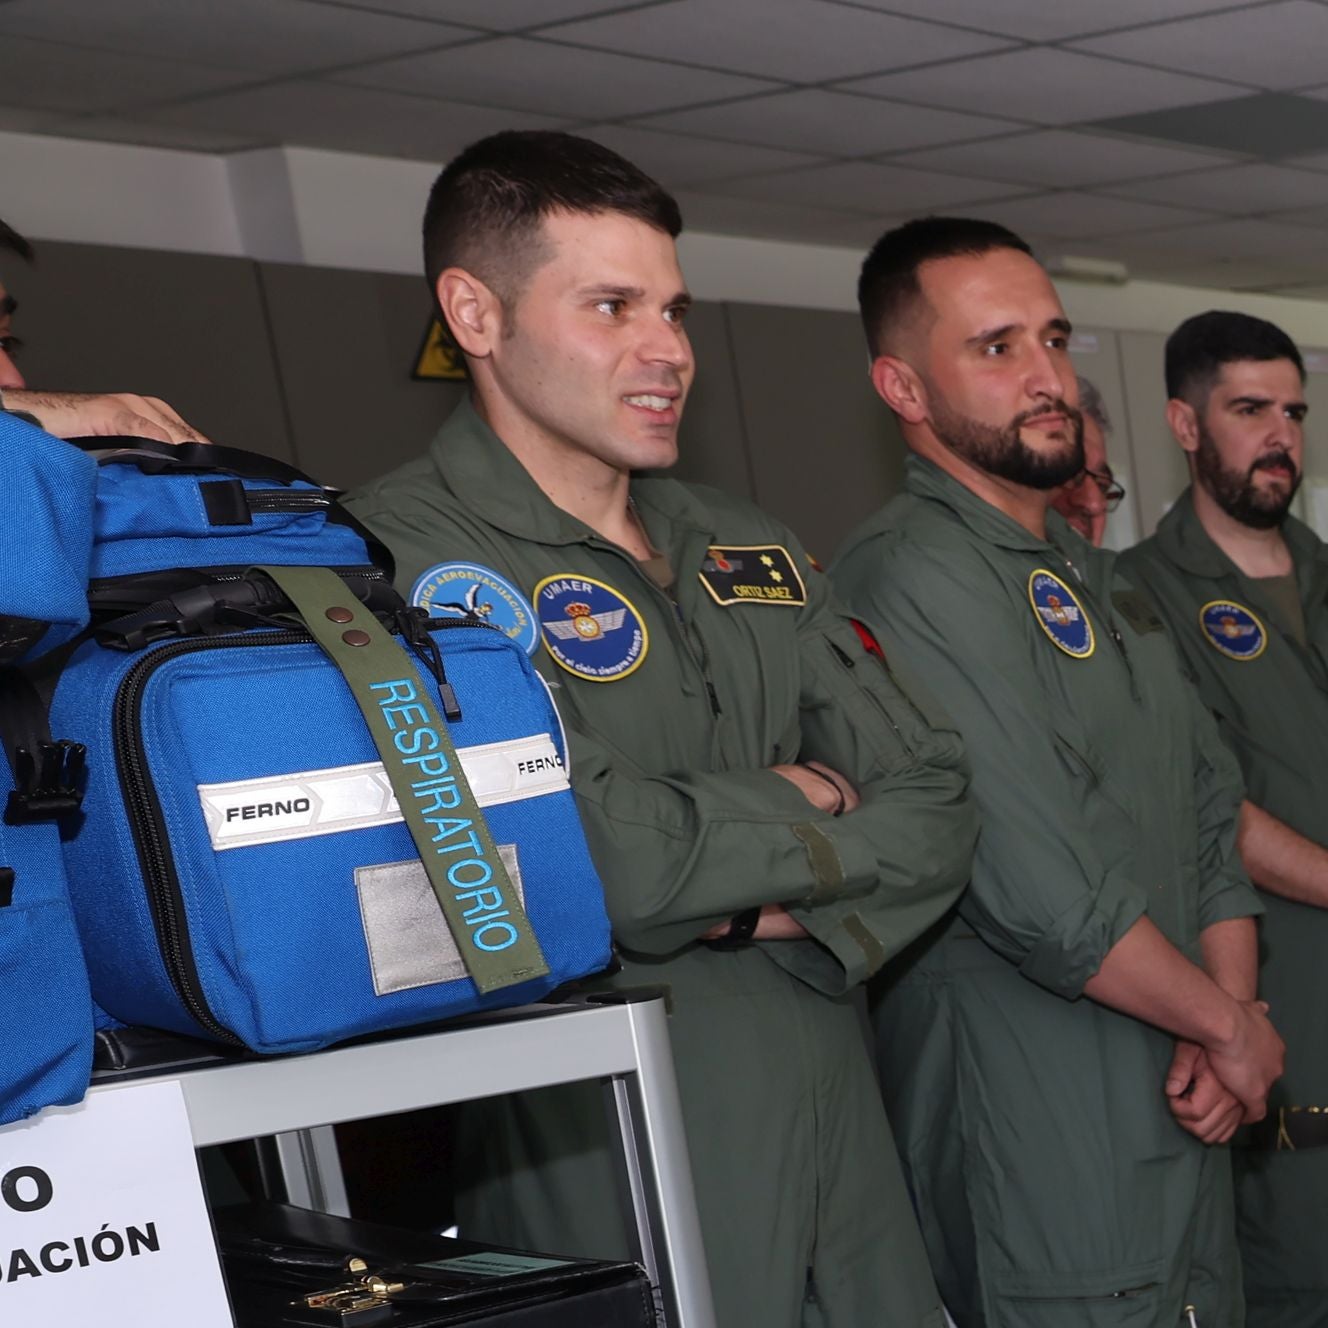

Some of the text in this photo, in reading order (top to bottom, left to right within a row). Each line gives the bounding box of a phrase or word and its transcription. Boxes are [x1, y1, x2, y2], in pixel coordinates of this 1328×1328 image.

[543, 580, 593, 600] UMAER
[733, 585, 793, 599] ORTIZ SAEZ
[552, 645, 565, 659] Por
[226, 797, 310, 823] FERNO
[369, 678, 519, 952] RESPIRATORIO
[0, 1222, 160, 1283] ACIÓN
